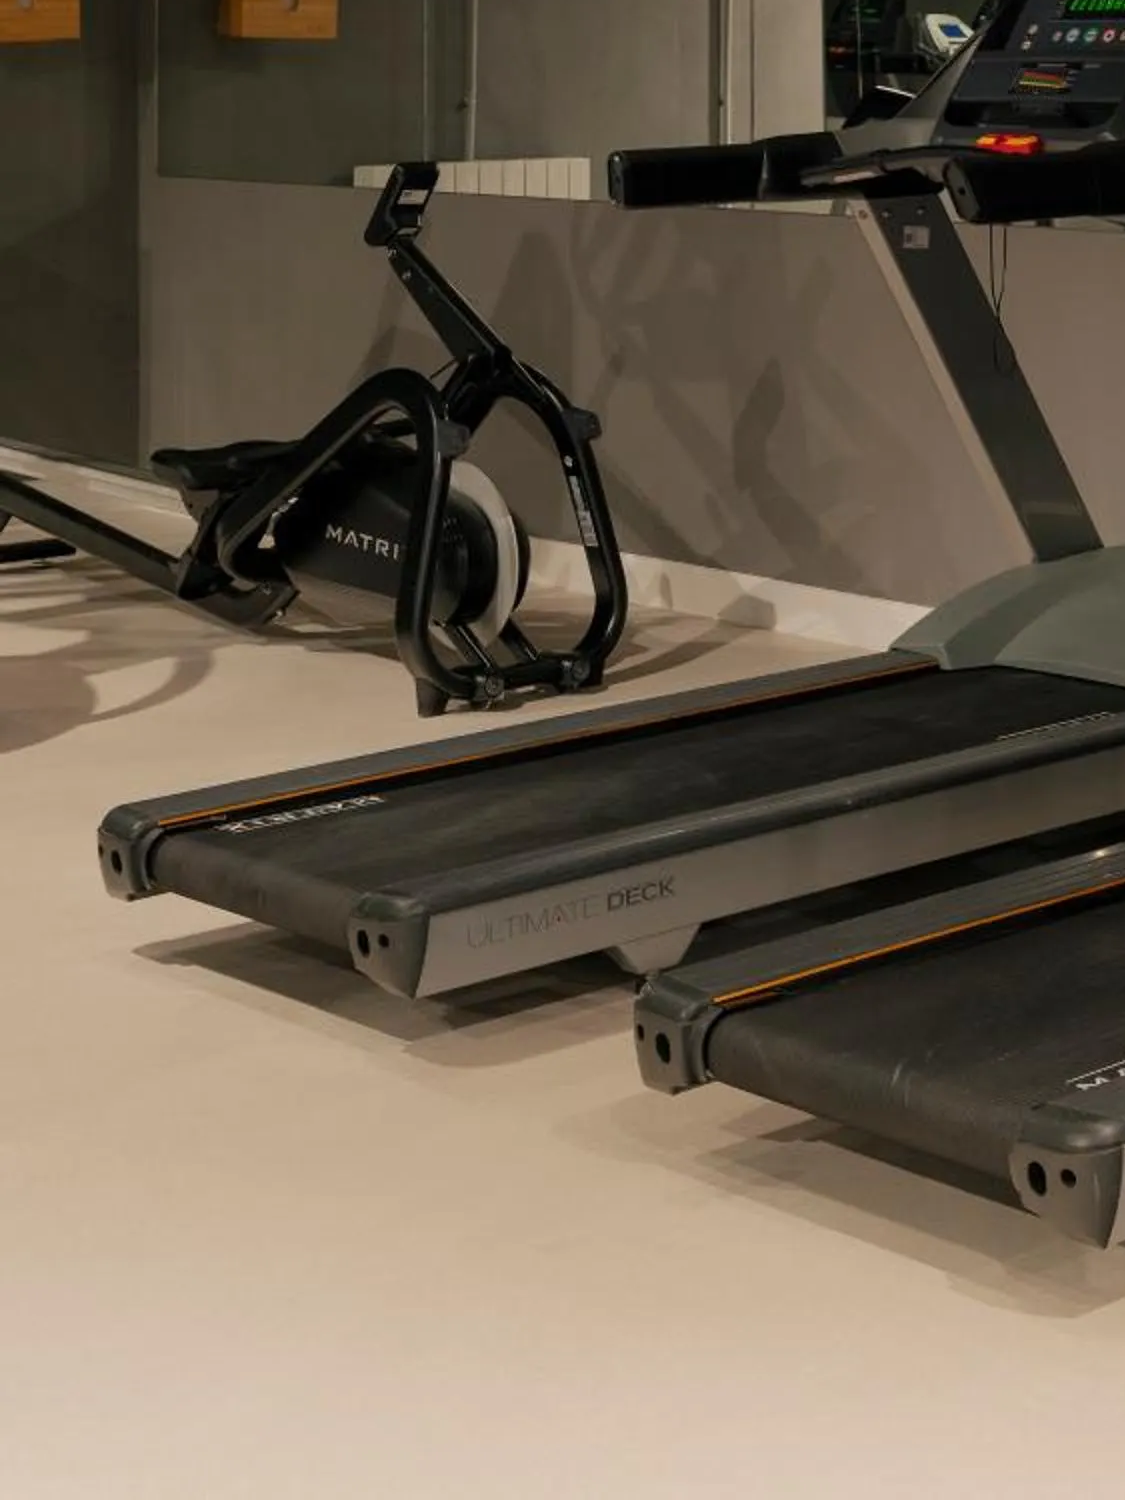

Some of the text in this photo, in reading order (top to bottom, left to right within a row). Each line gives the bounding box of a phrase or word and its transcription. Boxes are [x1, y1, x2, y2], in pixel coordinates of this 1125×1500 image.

[325, 523, 402, 560] MATRI
[466, 874, 677, 949] ULTIMATE DECK
